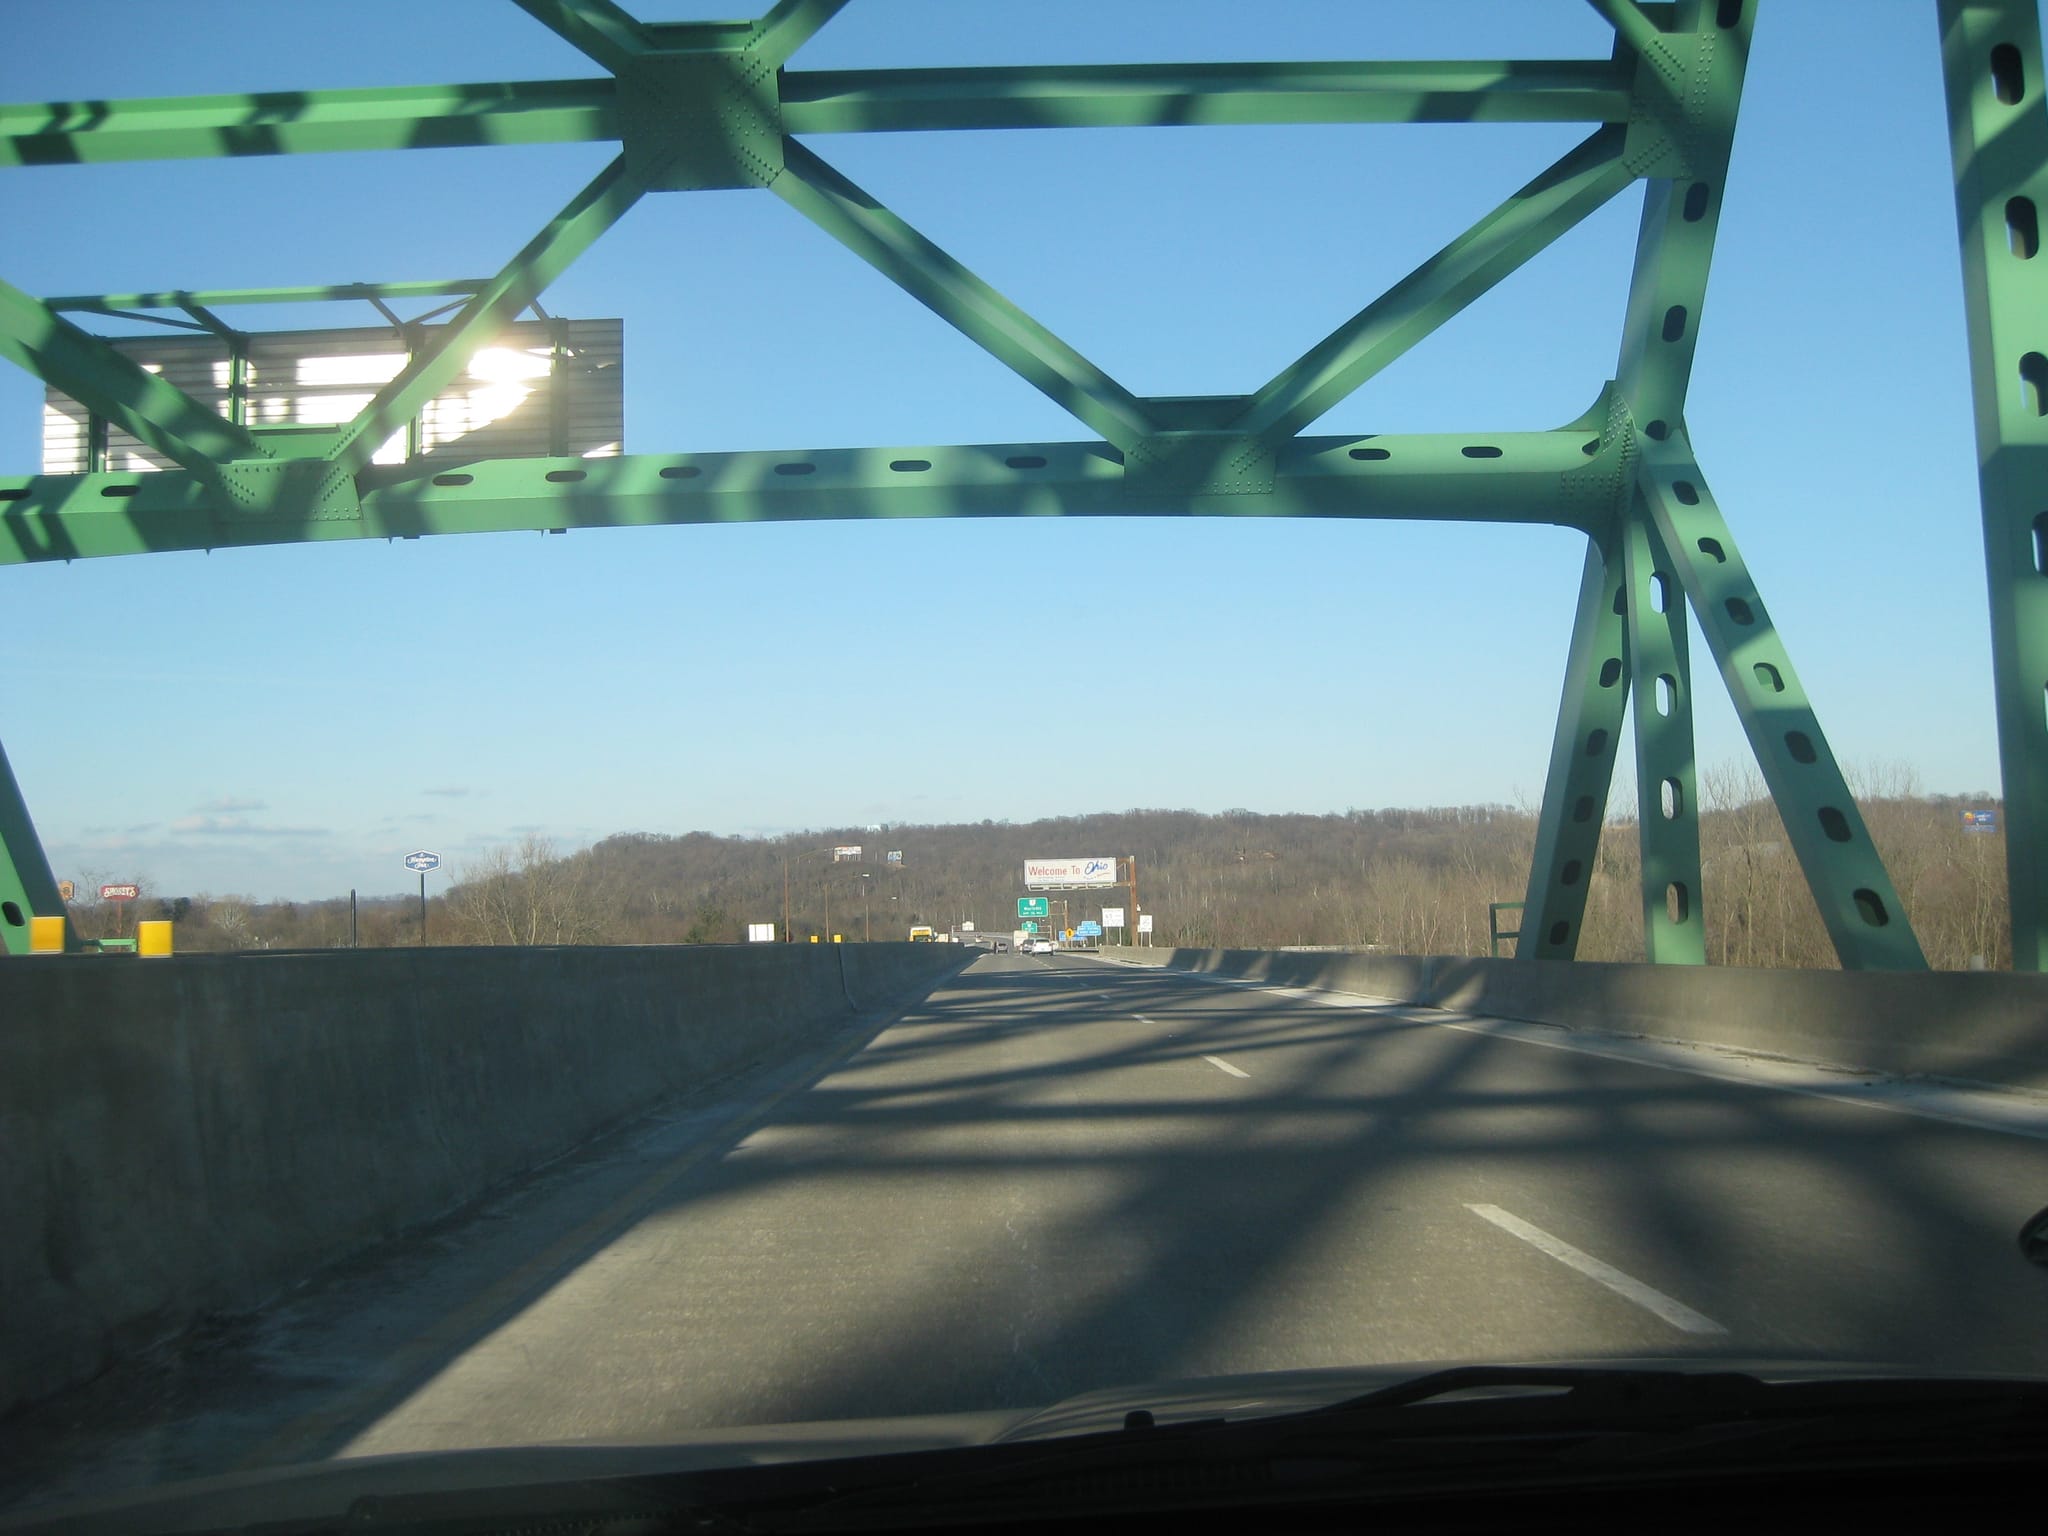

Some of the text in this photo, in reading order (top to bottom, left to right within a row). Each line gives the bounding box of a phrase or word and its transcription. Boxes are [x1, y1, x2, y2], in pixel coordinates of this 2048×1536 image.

[1028, 860, 1108, 876] Welcome To Ohio
